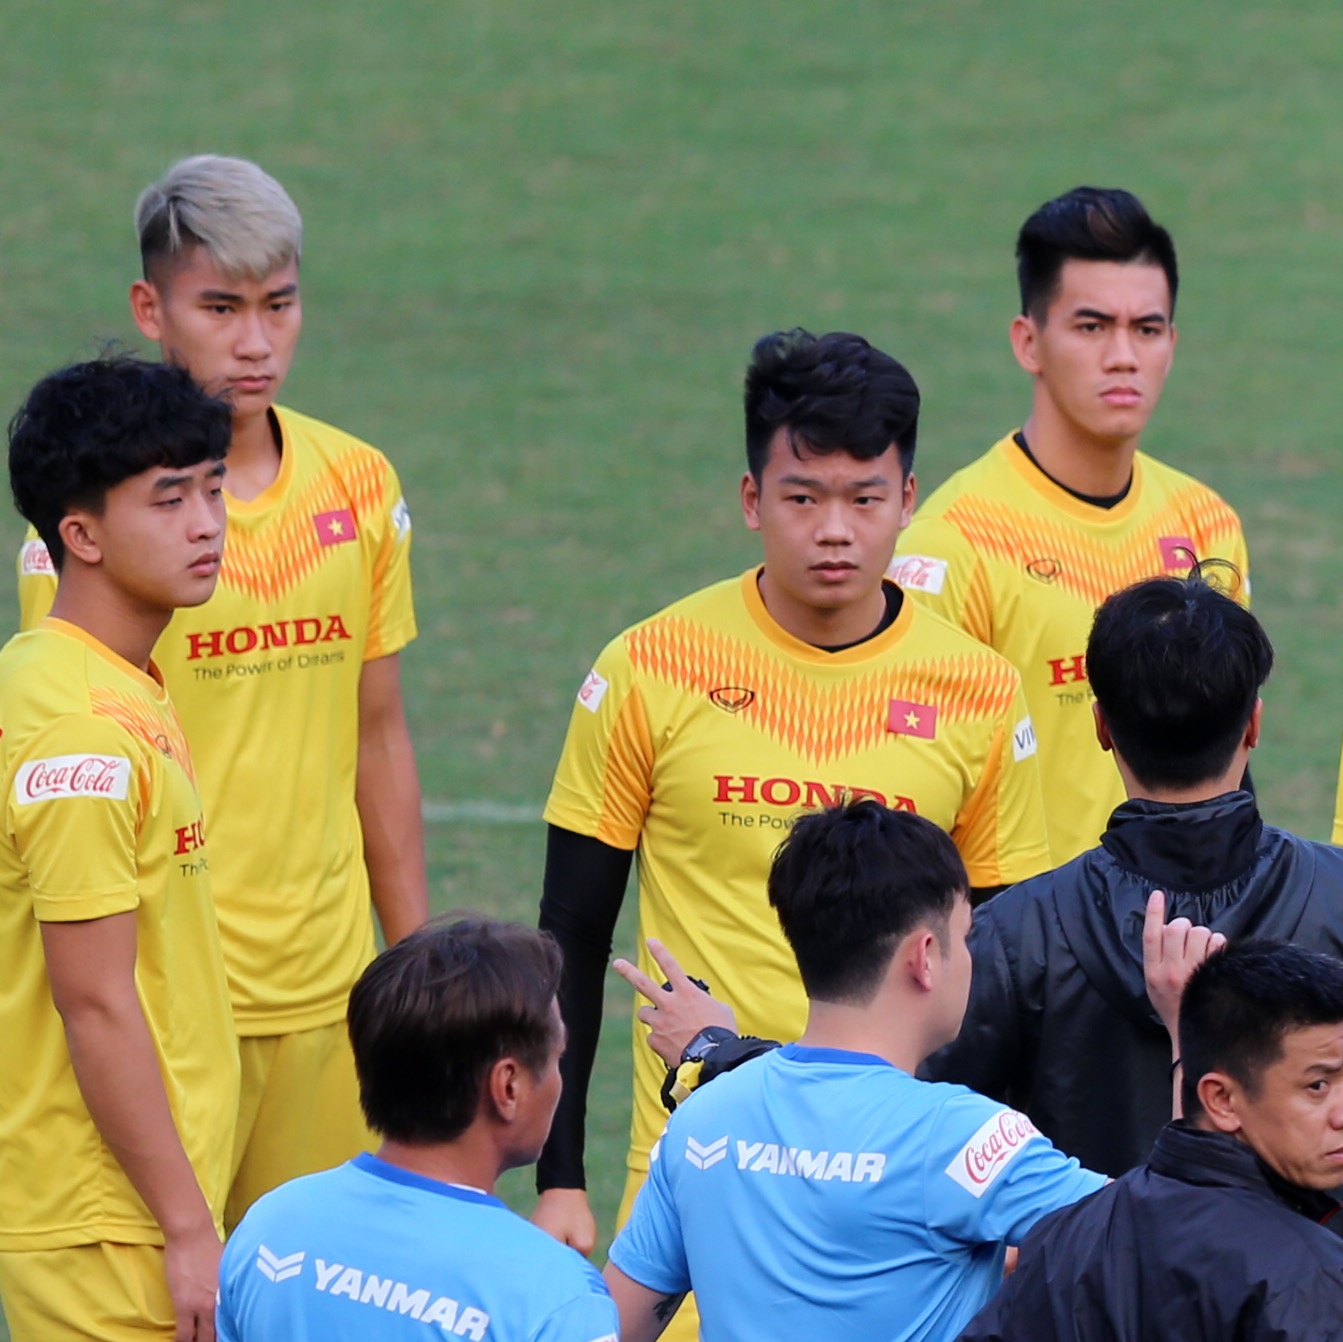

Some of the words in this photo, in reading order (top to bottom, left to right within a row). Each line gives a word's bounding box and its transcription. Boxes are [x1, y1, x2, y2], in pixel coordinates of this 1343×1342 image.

[186, 615, 352, 660] HONDA
[718, 811, 755, 828] The
[736, 1140, 886, 1183] YANMAR
[314, 1258, 490, 1342] YANMAR
